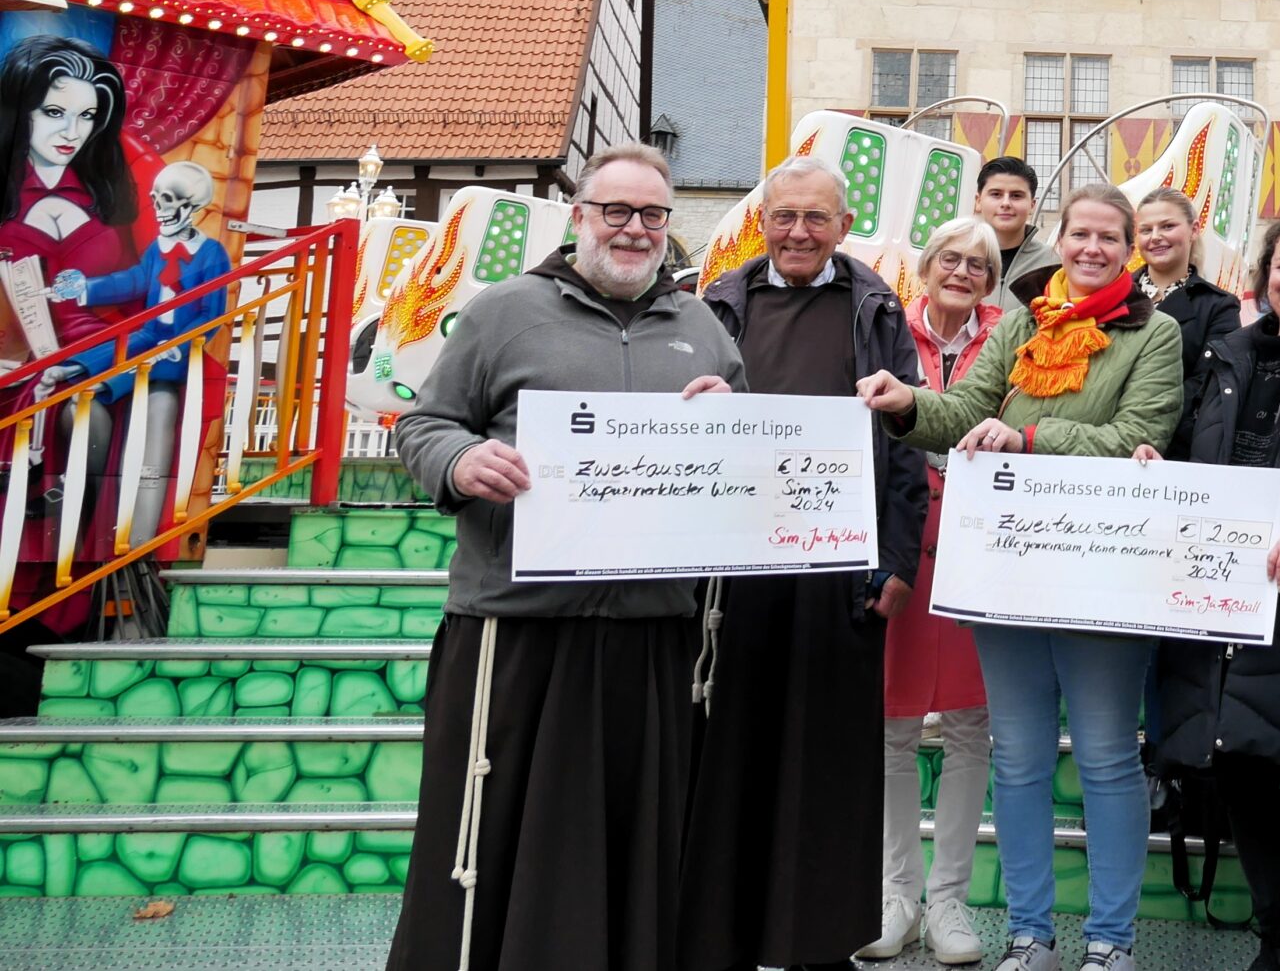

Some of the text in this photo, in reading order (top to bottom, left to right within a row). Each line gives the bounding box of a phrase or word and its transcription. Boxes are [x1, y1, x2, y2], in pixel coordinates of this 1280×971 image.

[606, 418, 802, 439] Sparkasse an der Lippe
[575, 455, 725, 478] Zweitausend
[801, 457, 849, 474] 2.000
[711, 481, 758, 497] Werne
[1024, 479, 1210, 506] Sparkasse an der Lippe
[790, 496, 834, 511] 2024
[998, 513, 1150, 537] Zweitausend
[1206, 524, 1262, 545] 2.000
[992, 536, 1020, 549] Alle
[1188, 564, 1232, 582] 2024
